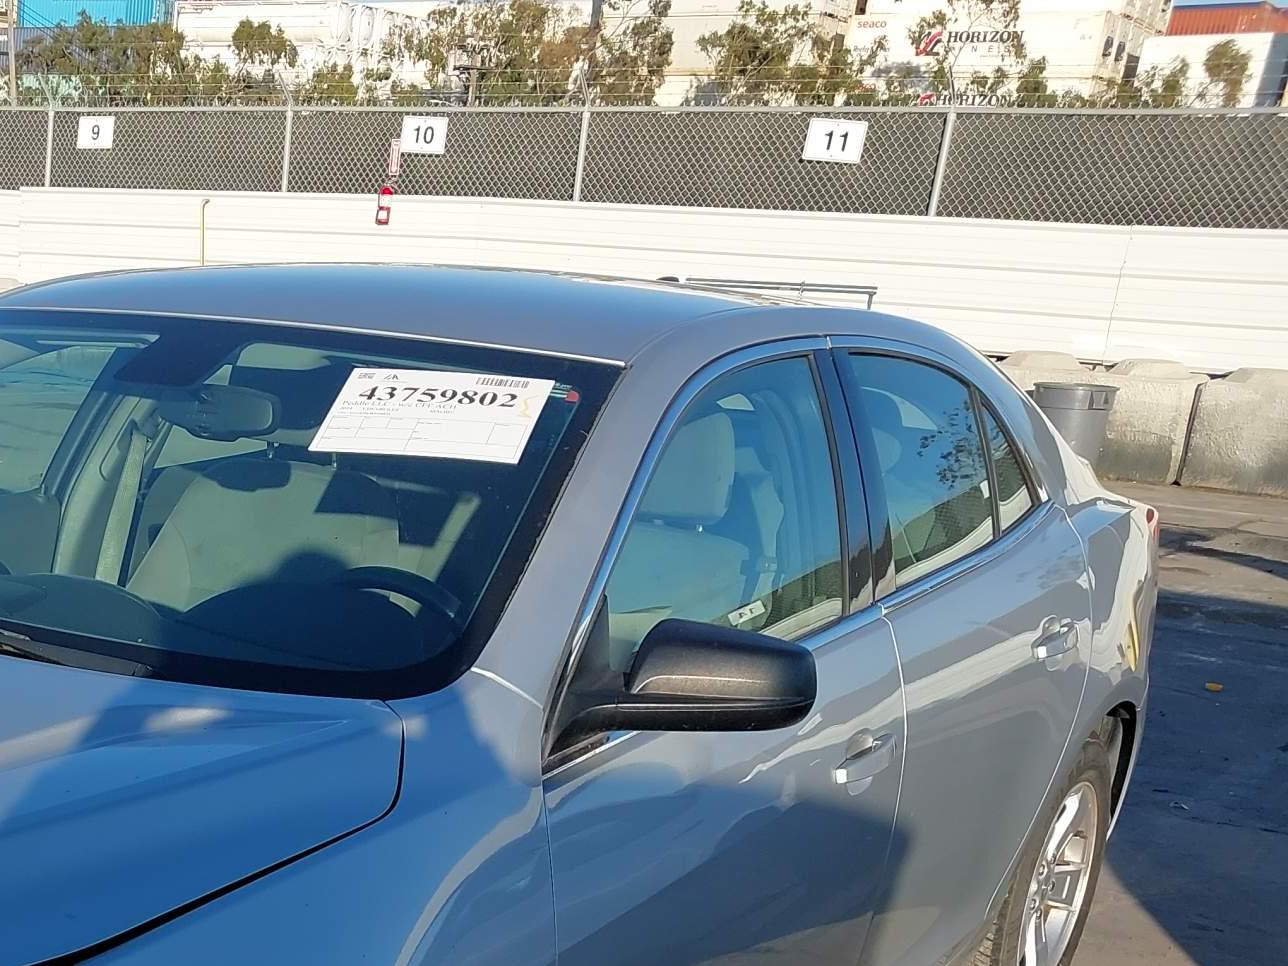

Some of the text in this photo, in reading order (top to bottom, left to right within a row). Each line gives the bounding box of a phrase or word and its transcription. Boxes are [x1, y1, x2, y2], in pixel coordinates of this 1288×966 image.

[857, 20, 887, 28] seaco
[948, 30, 1024, 43] HORIZON
[91, 124, 100, 141] 9
[413, 125, 435, 145] 10
[824, 130, 849, 152] 11
[358, 385, 518, 408] 43759802
